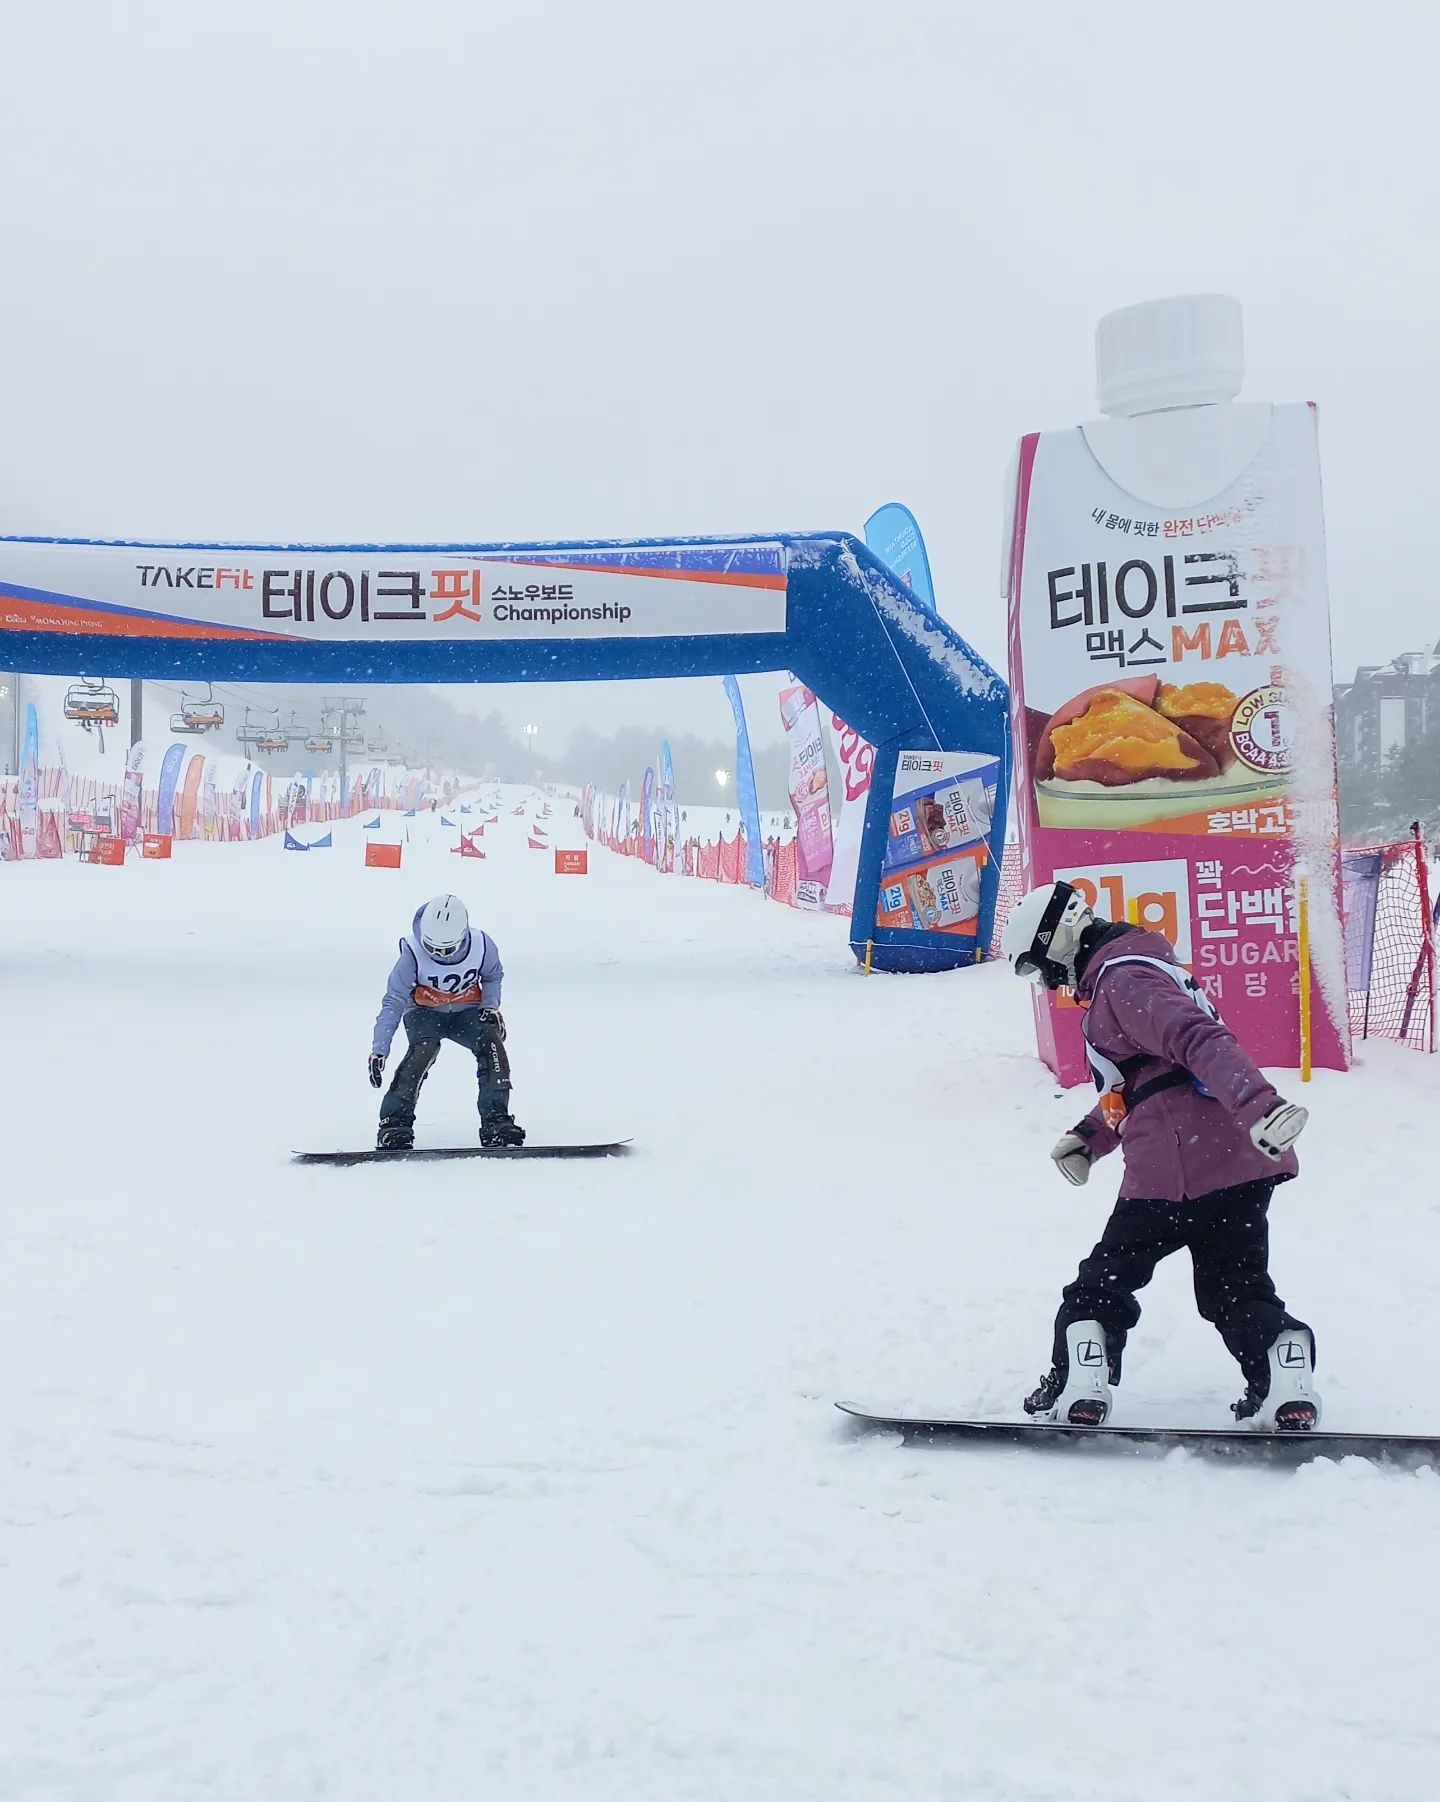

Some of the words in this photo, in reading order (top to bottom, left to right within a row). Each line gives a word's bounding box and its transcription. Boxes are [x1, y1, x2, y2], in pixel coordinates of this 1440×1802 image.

[1091, 507, 1107, 523] 내
[1105, 513, 1132, 534] 몸에
[1133, 521, 1160, 537] 핏한
[1163, 517, 1194, 538] 완전
[262, 569, 482, 622] 테이크핏
[491, 584, 574, 602] 스노우보드
[493, 602, 632, 625] Championship
[1236, 694, 1265, 726] LOW
[1235, 732, 1268, 766] BCAA
[901, 760, 944, 772] 테이크핏
[899, 811, 911, 832] 21g
[949, 790, 971, 836] 테이크핏
[889, 886, 901, 909] 21g
[941, 869, 962, 915] 테이크핏
[1200, 940, 1299, 968] SUGAR
[427, 968, 478, 994] 122
